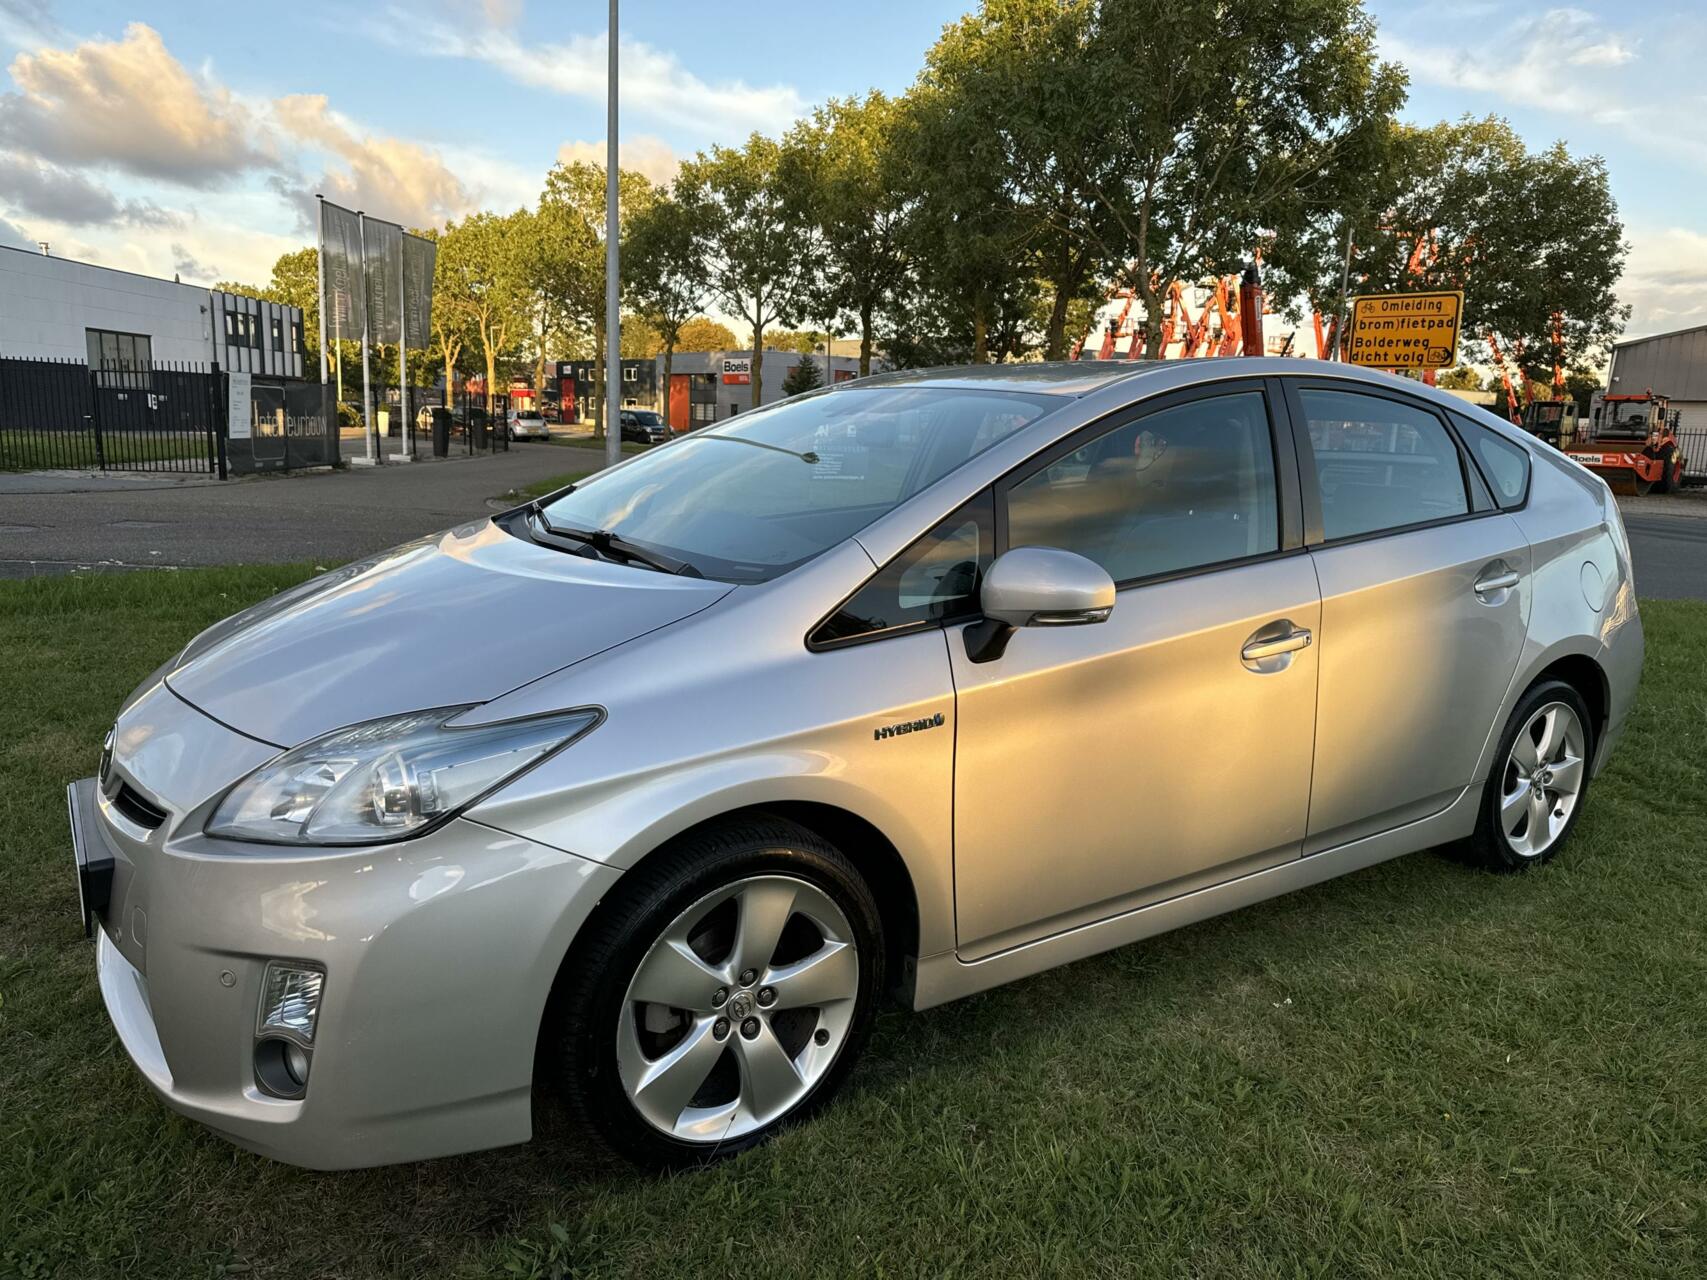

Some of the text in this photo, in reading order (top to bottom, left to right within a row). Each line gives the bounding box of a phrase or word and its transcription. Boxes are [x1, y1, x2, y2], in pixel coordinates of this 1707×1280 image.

[1381, 299, 1442, 312] Omleiding
[1355, 317, 1454, 332] (brom)fietpad
[1355, 336, 1430, 350] Bolderweg
[1352, 351, 1425, 364] dicht volg
[724, 361, 749, 372] Boels
[873, 717, 934, 741] HYBRID
